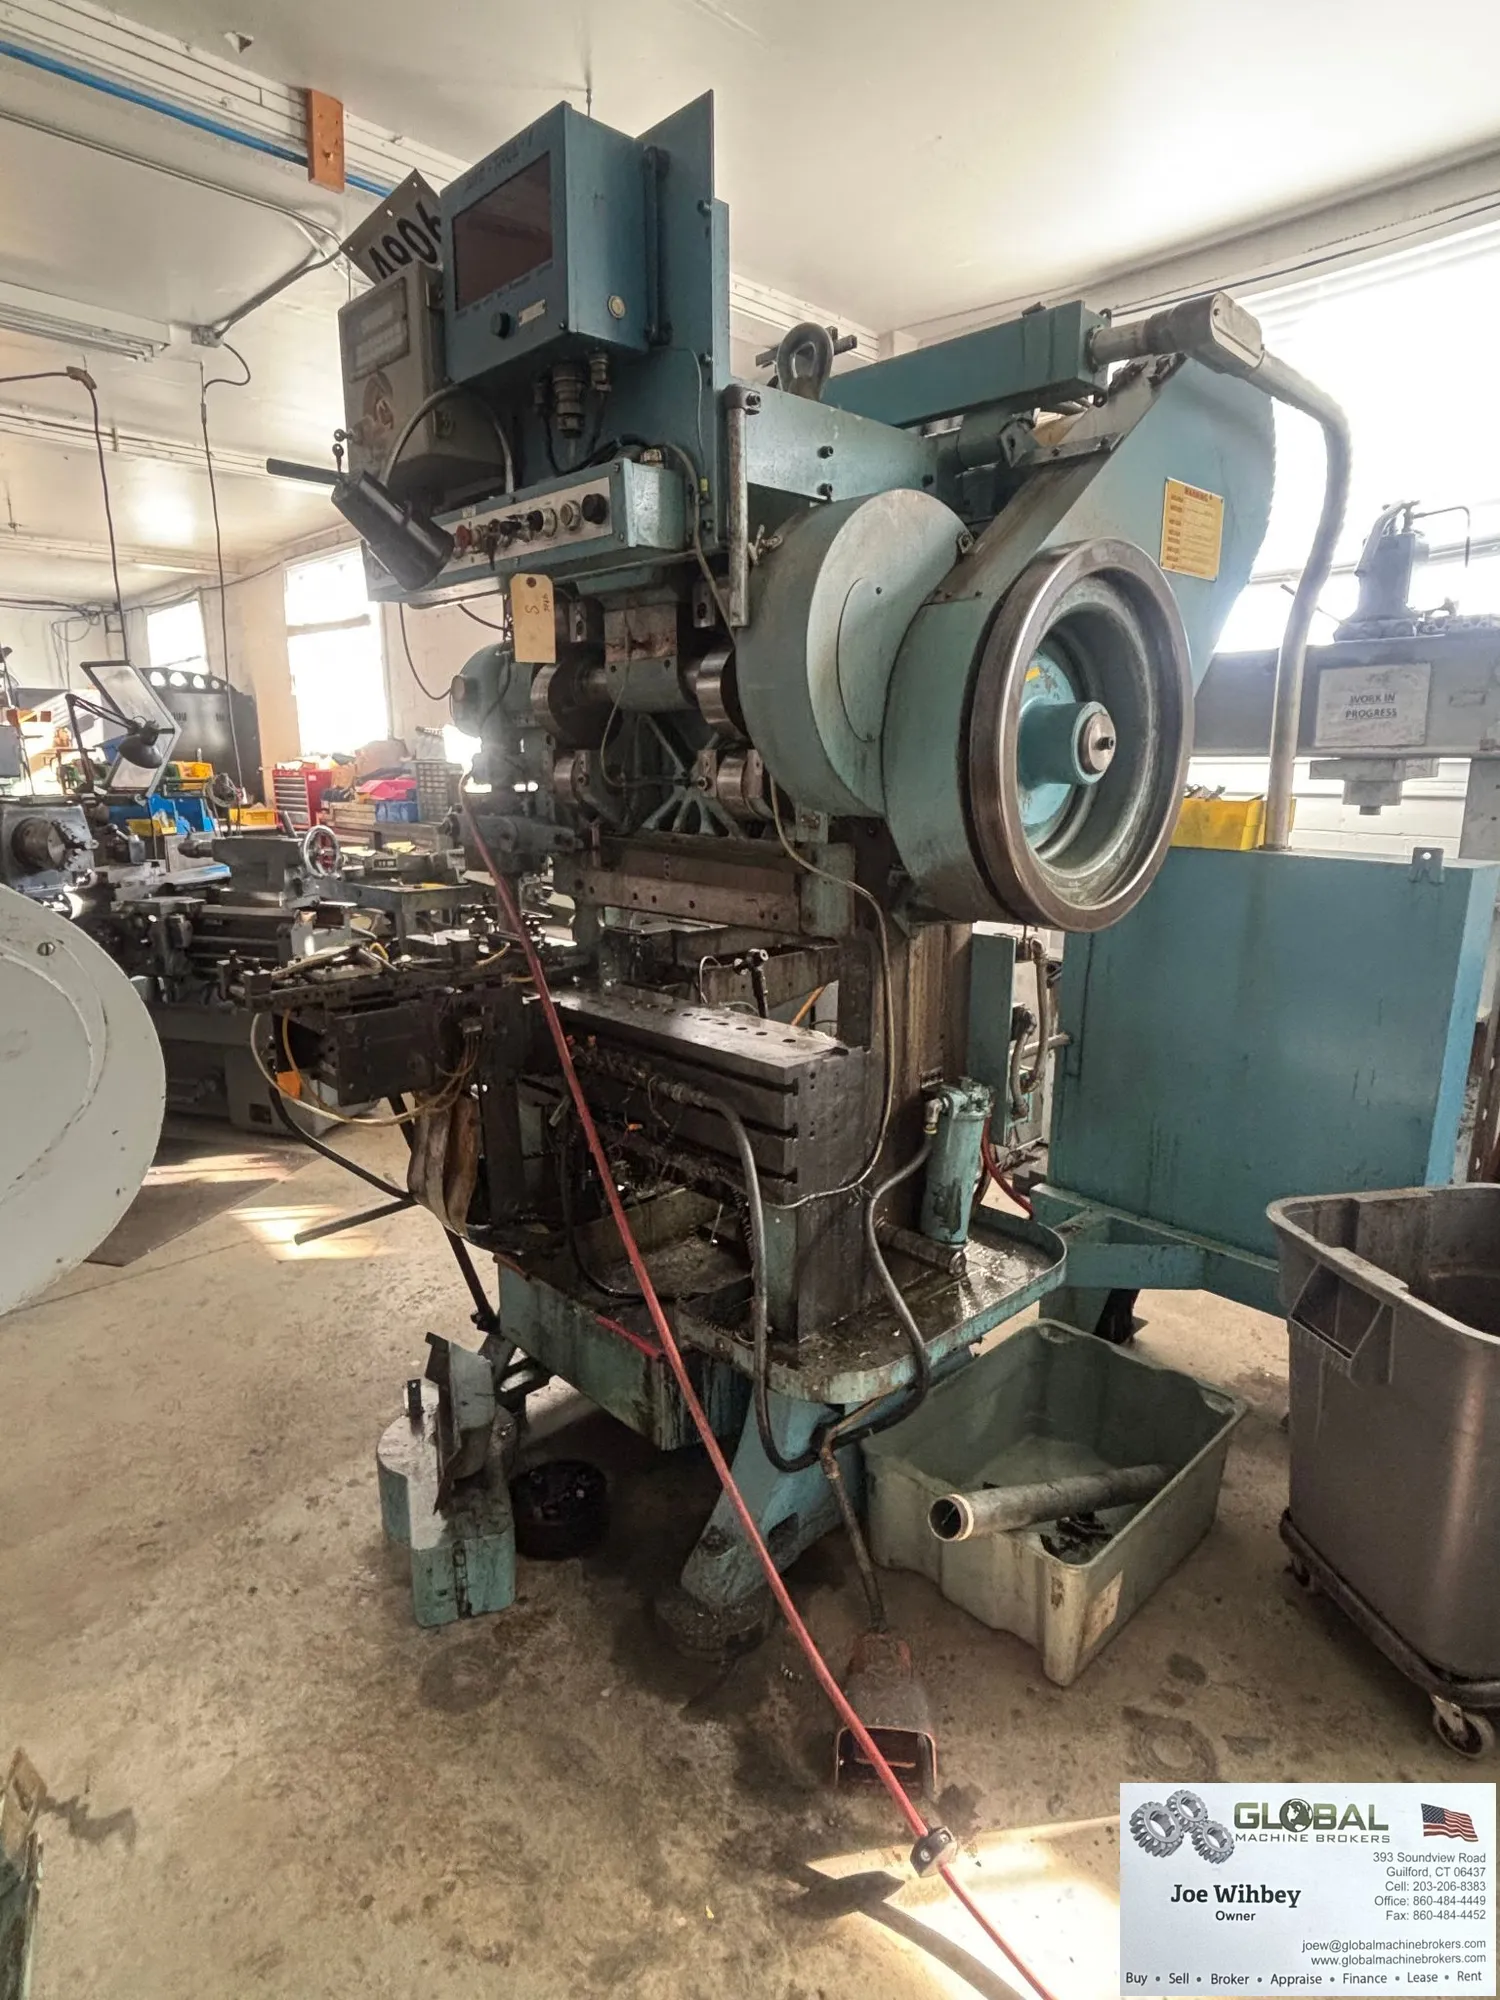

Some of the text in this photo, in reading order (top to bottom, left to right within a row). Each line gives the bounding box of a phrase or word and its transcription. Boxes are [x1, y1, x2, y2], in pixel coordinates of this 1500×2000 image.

[1350, 693, 1396, 703] WORK IN
[1345, 708, 1397, 718] PROGRESS
